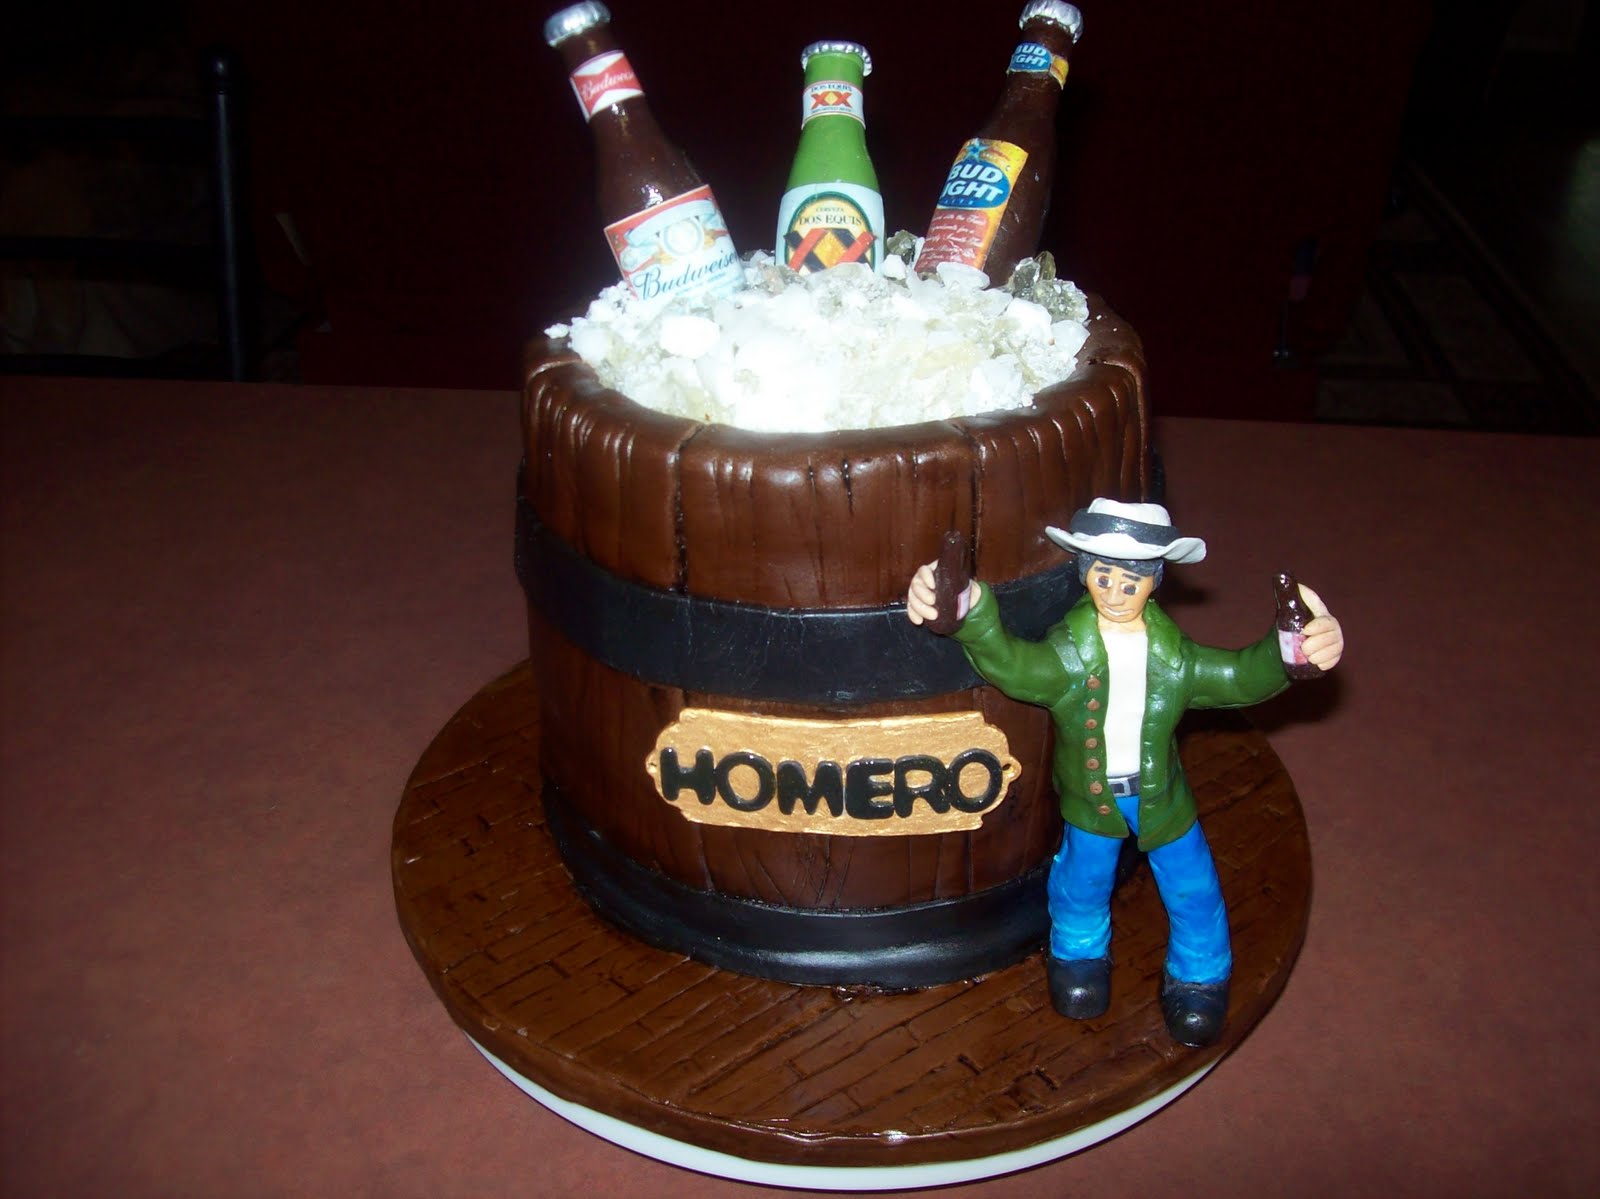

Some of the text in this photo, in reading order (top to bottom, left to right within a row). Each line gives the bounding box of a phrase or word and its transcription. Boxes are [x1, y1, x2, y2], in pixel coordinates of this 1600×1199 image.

[1012, 54, 1048, 67] GHT
[949, 163, 1003, 184] BUD
[940, 180, 1004, 202] IGHT
[799, 213, 863, 226] DOS EQUIS
[659, 746, 1004, 820] HOMERO
